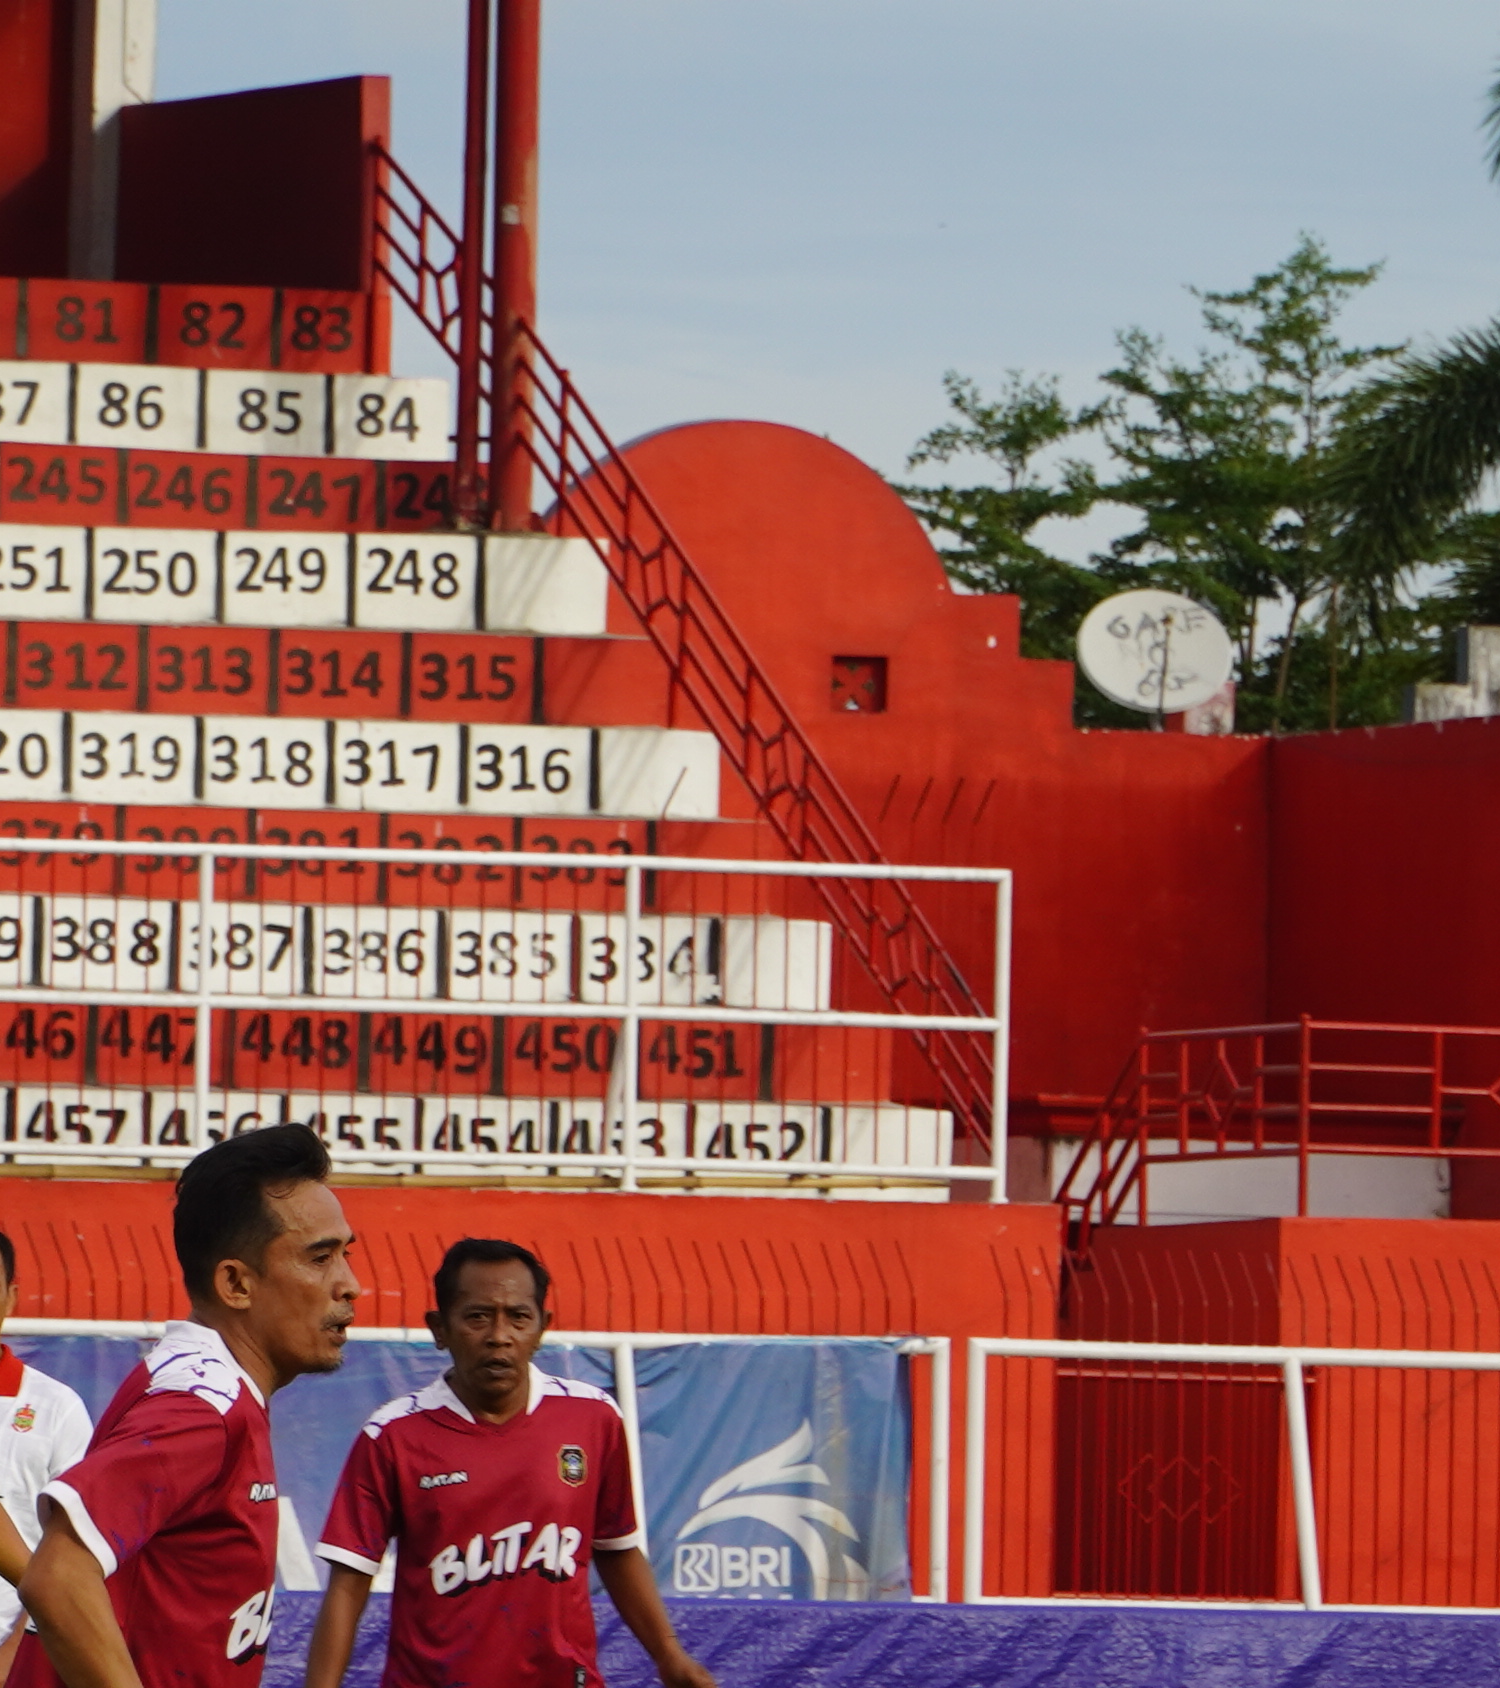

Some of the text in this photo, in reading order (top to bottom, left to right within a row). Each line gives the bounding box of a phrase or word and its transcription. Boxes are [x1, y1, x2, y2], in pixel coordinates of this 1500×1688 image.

[179, 302, 245, 348] 82
[291, 305, 351, 351] 83
[99, 382, 163, 429] 86
[238, 389, 301, 435] 85
[356, 393, 418, 440] 84
[8, 456, 105, 504] 245
[103, 548, 196, 596] 250
[236, 547, 326, 593] 249
[367, 548, 458, 599] 248
[157, 646, 253, 695] 313
[286, 648, 383, 697] 314
[81, 732, 180, 782] 319
[210, 735, 313, 786] 318
[344, 739, 439, 791] 317
[476, 744, 570, 793] 316
[51, 916, 159, 966] 388
[428, 1521, 583, 1596] BLITAR
[722, 1546, 791, 1588] BRI
